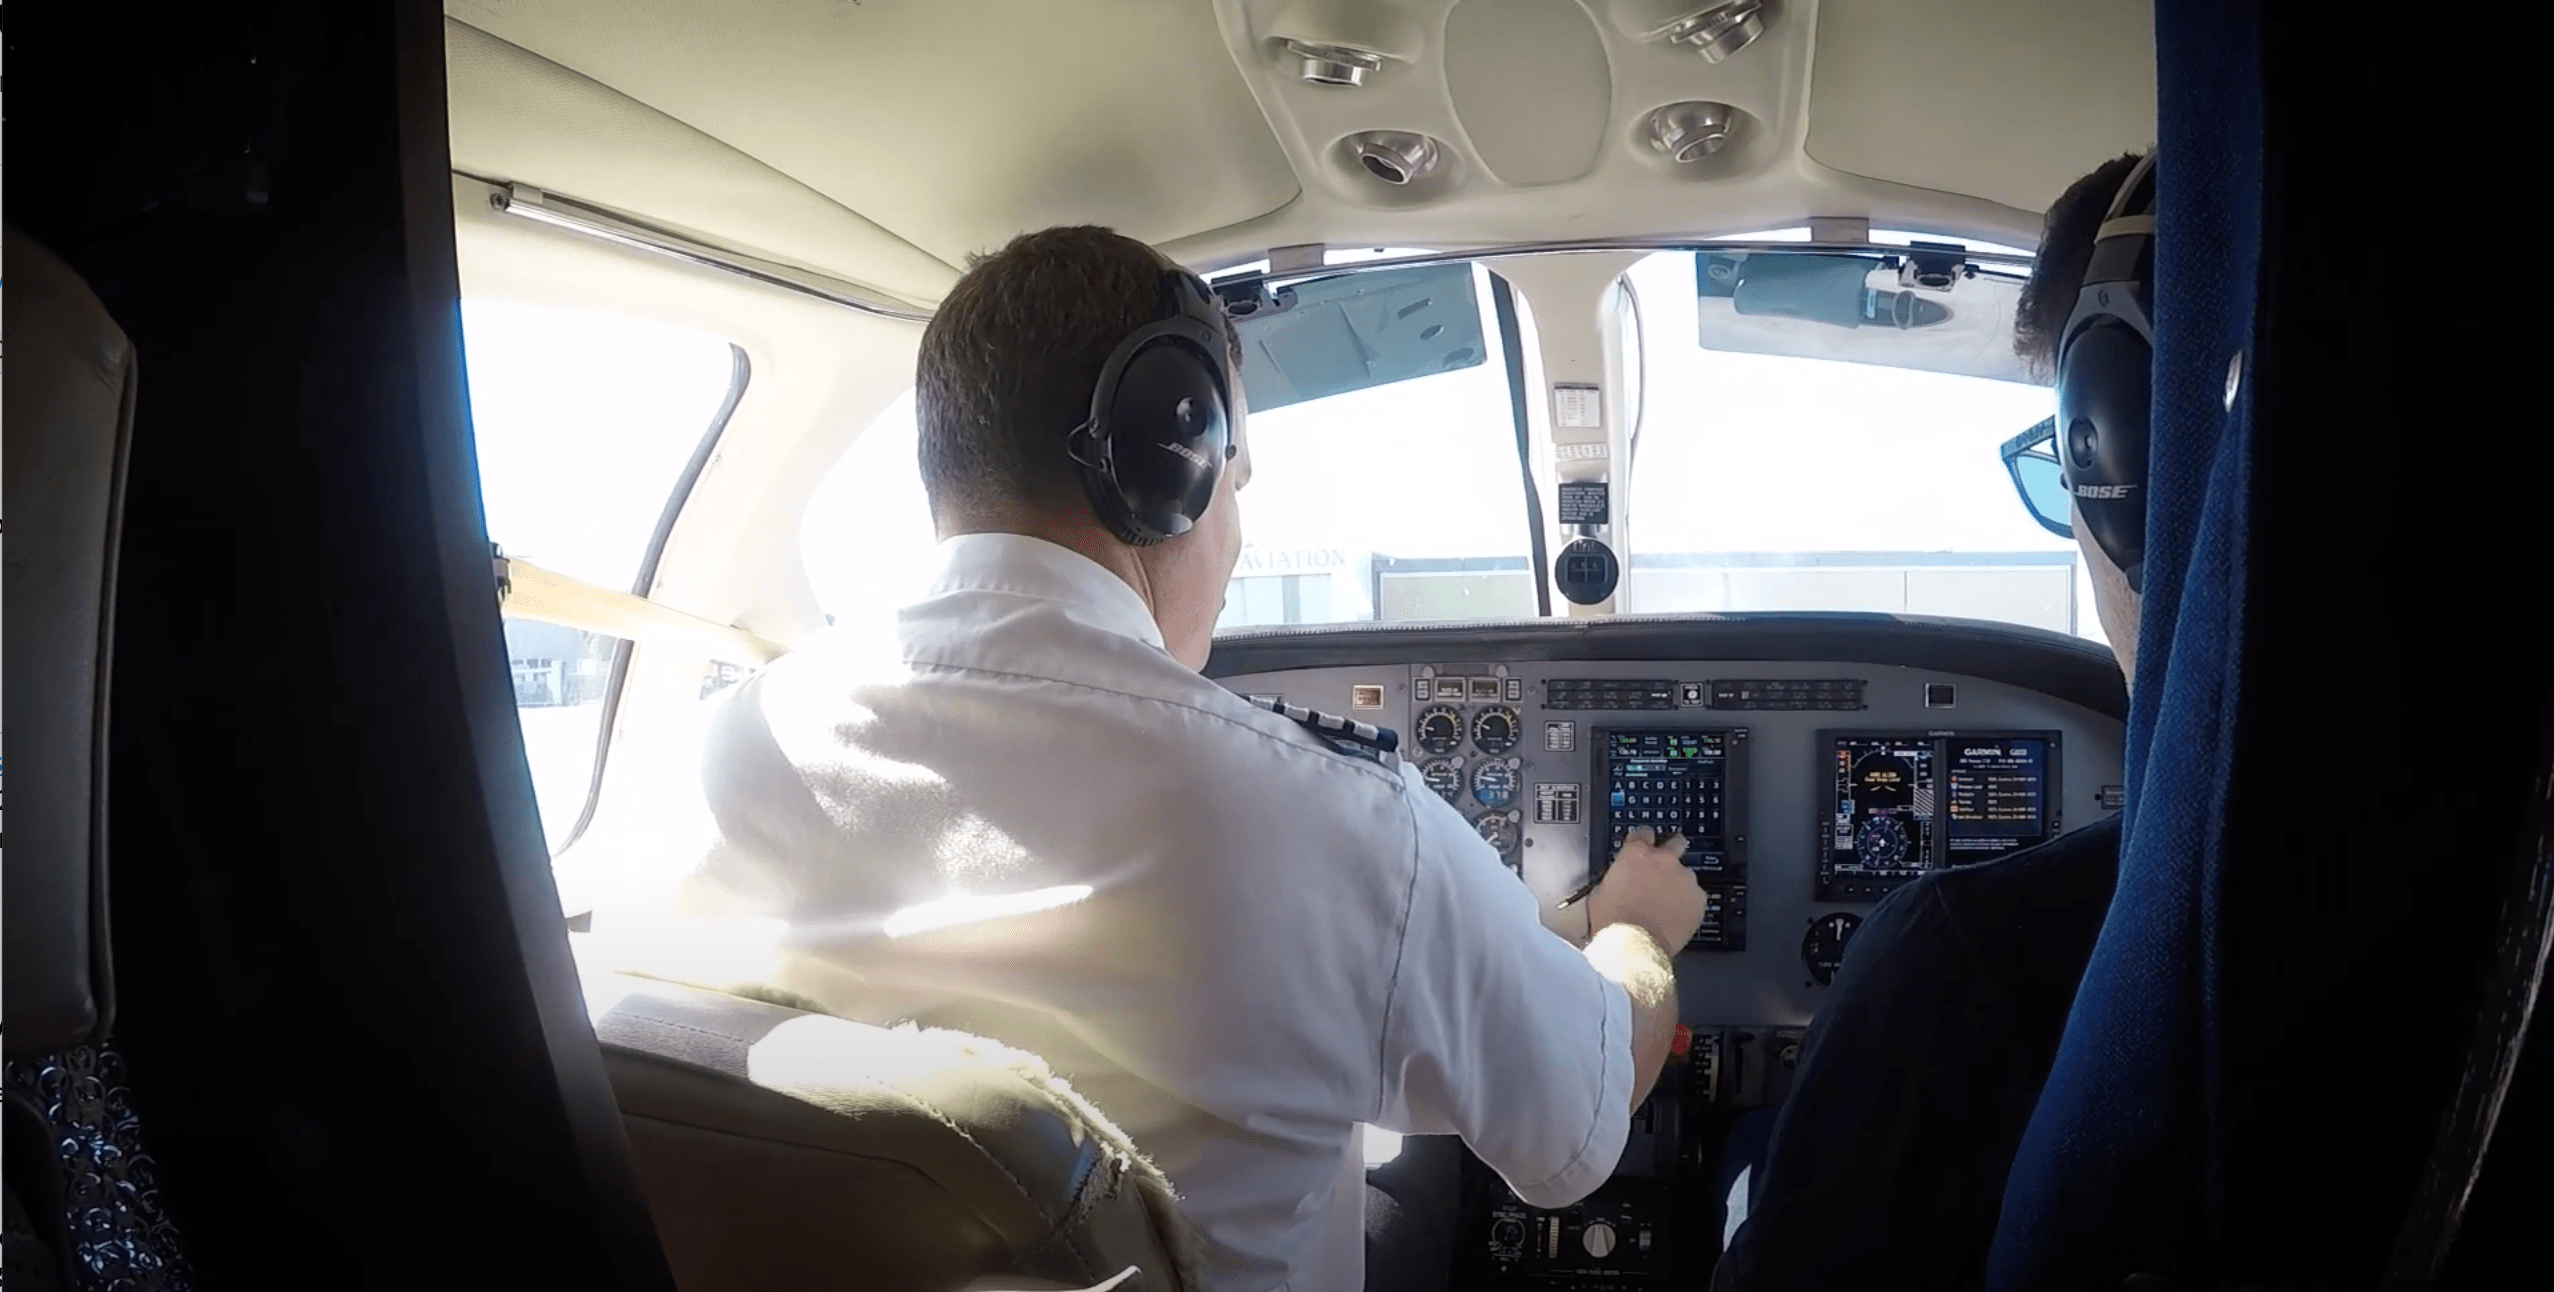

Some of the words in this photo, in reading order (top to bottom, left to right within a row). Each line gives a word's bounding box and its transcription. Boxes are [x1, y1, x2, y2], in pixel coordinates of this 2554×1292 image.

[1160, 442, 1211, 469] BOSE
[2076, 484, 2132, 499] BOSE
[1238, 549, 1346, 570] AVIATION
[1964, 748, 2001, 756] GARMIN
